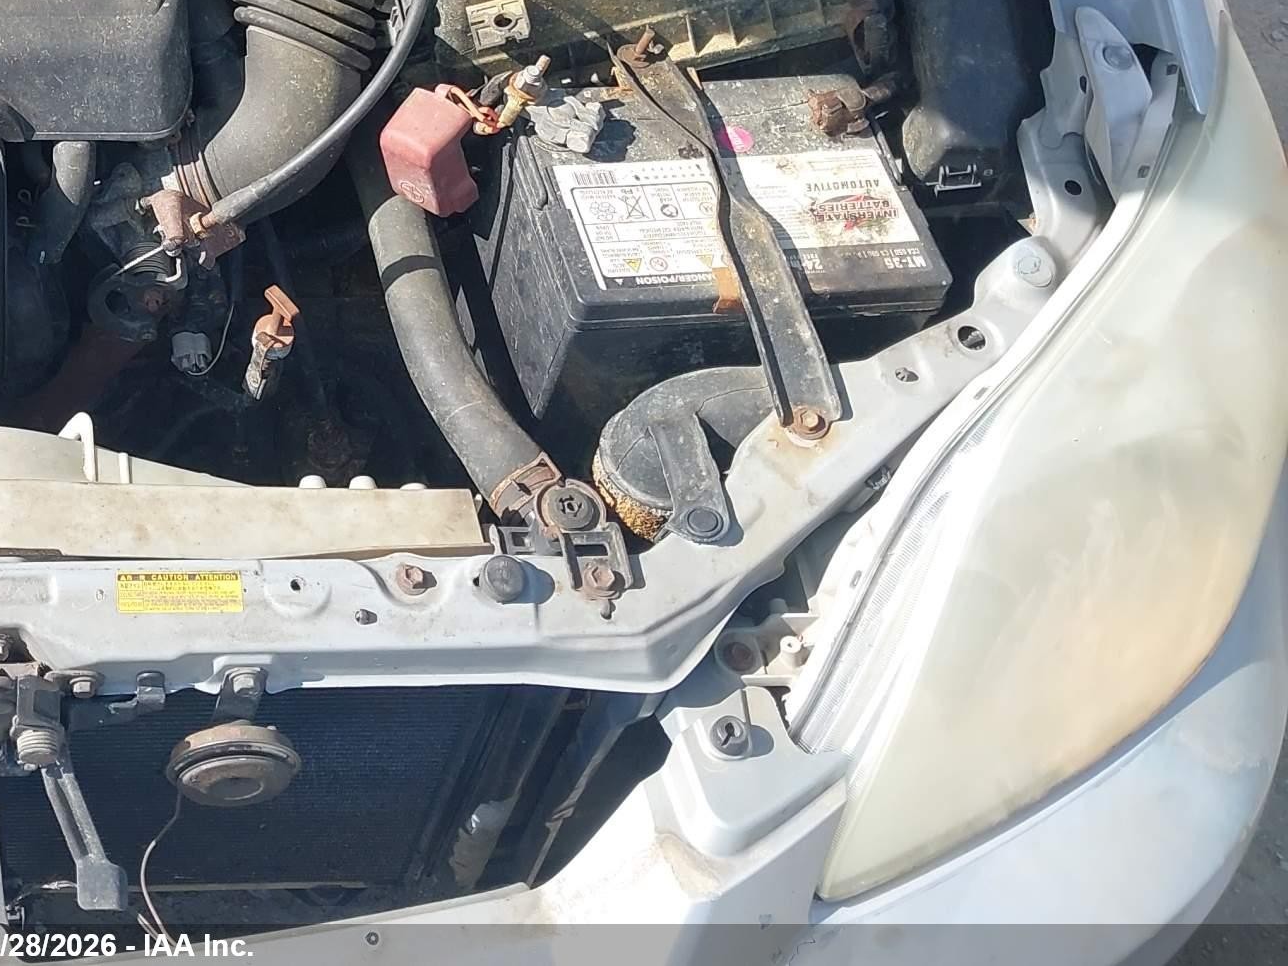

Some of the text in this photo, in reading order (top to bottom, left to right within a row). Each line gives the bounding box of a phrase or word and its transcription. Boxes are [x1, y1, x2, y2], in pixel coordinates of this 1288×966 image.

[805, 179, 880, 192] AUTOMOTIVE
[818, 199, 890, 212] BATTERIES
[815, 209, 898, 223] INTERSTATE
[636, 273, 714, 285] ANGER/POISON
